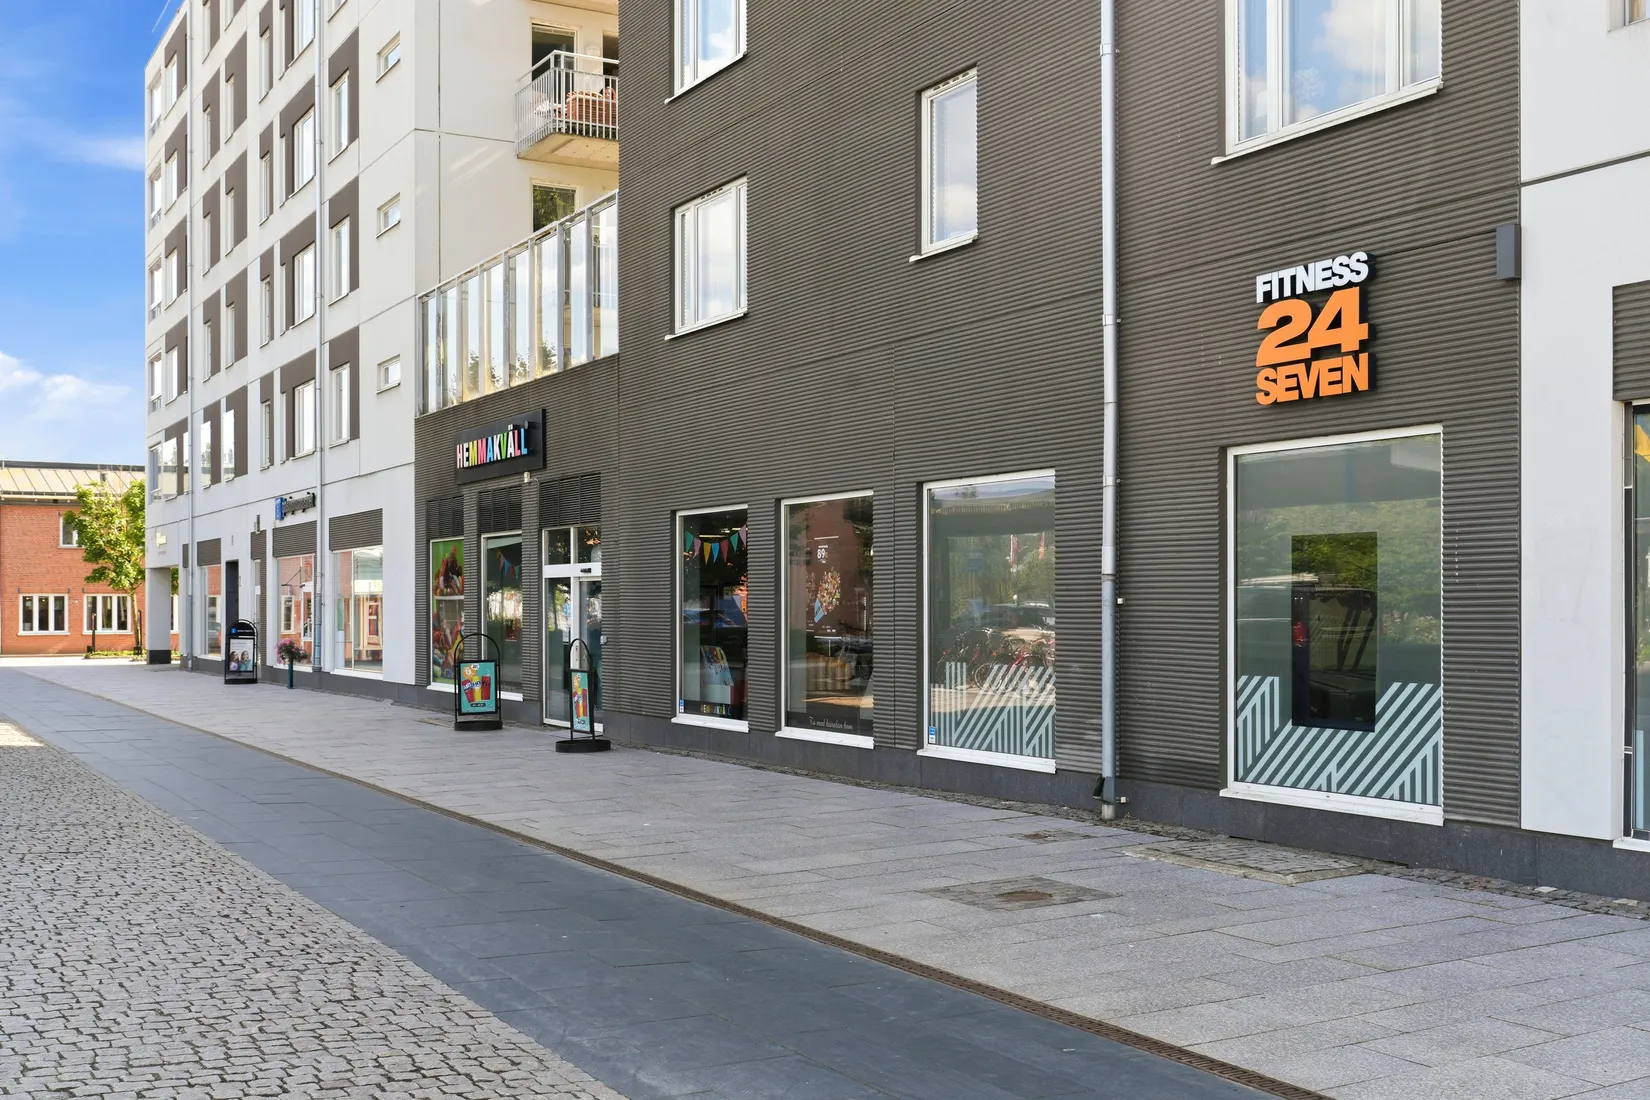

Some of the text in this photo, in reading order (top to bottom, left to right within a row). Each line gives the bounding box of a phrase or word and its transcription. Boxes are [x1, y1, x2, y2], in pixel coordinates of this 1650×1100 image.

[1256, 251, 1369, 303] FITNESS
[1256, 287, 1369, 367] 24
[1256, 352, 1369, 405] SEVEN
[456, 424, 528, 469] HEMMAKVÄLL
